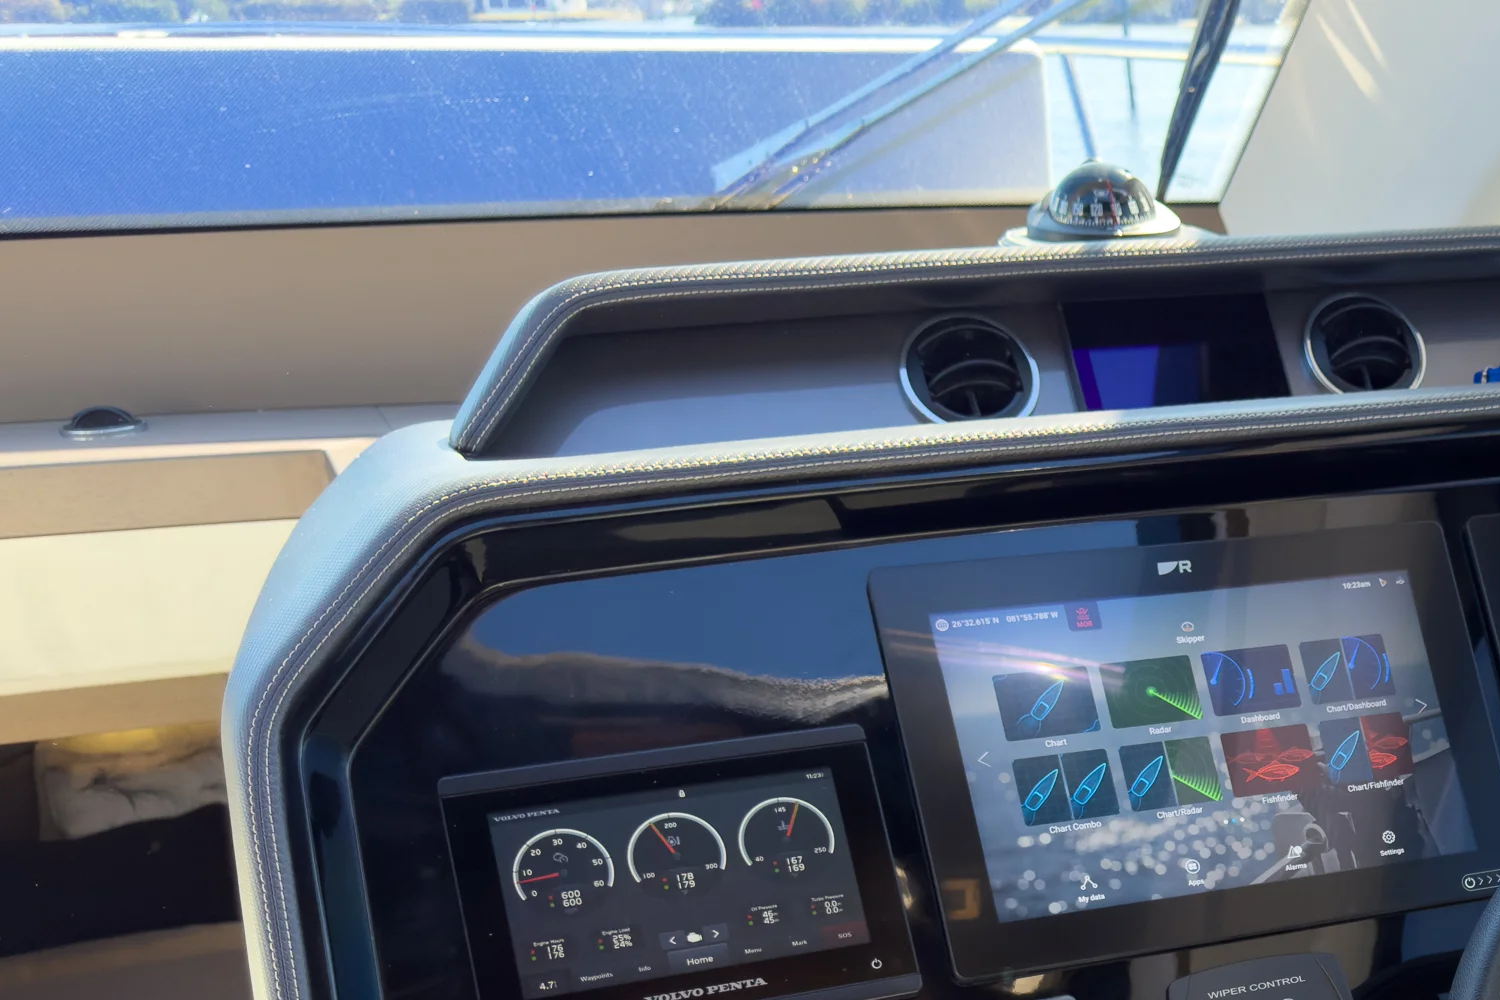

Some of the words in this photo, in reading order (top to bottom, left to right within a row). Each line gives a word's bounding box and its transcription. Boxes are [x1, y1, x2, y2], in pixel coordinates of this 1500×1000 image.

[1176, 633, 1205, 645] Skipper
[1326, 699, 1387, 714] Chart/Dashboard
[1240, 712, 1281, 724] Dashboard
[1149, 725, 1172, 736] Radar
[1045, 738, 1067, 748] Chart
[1347, 777, 1405, 793] Chart/Fishfinder
[1262, 792, 1298, 805] Fishfinder
[493, 813, 525, 822] VOLVO
[527, 808, 560, 818] PENTA
[1156, 806, 1203, 820] Chart/Radar
[1049, 823, 1072, 834] Chart
[1072, 820, 1102, 831] Combo
[552, 838, 563, 846] 30
[1380, 847, 1405, 858] Settings
[592, 858, 603, 866] 50
[786, 856, 803, 865] 167
[788, 863, 805, 873] 169
[1285, 862, 1308, 872] Alarms
[676, 872, 695, 881] 178
[1188, 877, 1205, 887] Apps
[678, 880, 696, 889] 179
[561, 889, 581, 900] 600
[1078, 894, 1090, 904] My
[1091, 892, 1105, 902] data
[562, 897, 583, 907] 600
[686, 953, 714, 966] Home
[580, 972, 613, 983] Waypoints
[707, 976, 768, 997] PENTA
[1207, 986, 1247, 1000] WIPER
[1249, 975, 1306, 992] CONTROL
